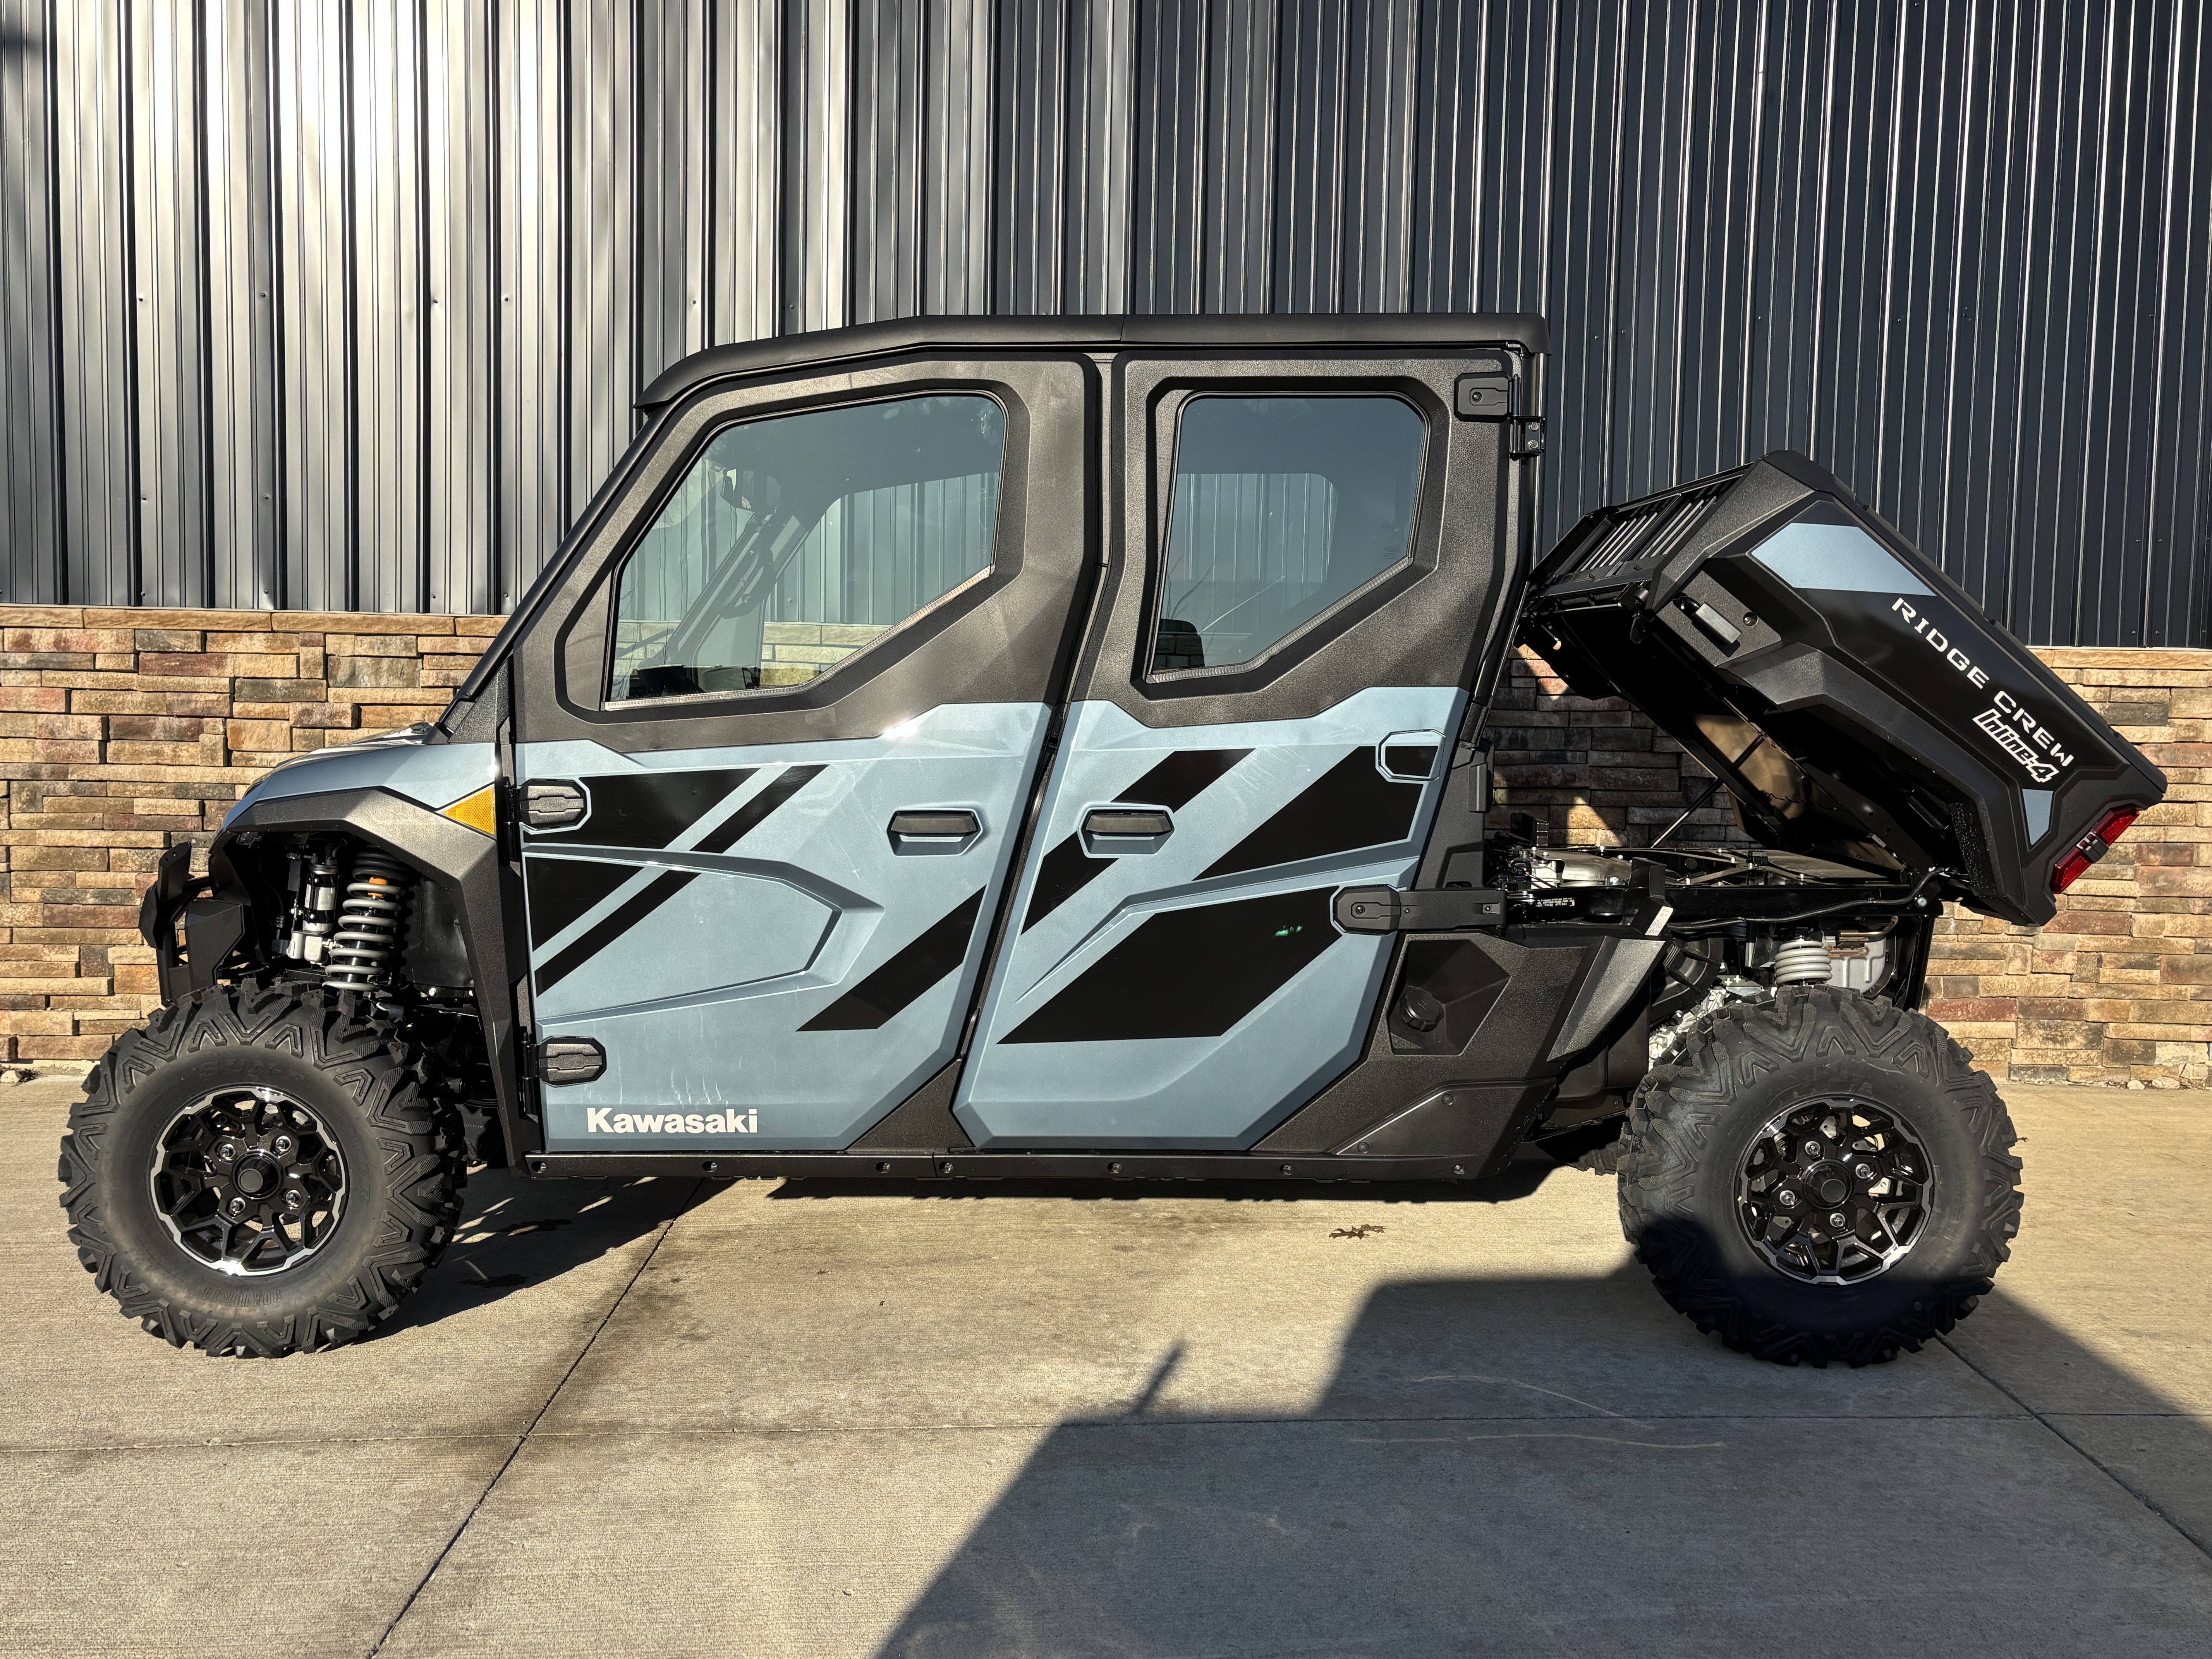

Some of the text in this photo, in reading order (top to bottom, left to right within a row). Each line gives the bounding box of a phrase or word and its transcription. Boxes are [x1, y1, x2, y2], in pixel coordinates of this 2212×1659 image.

[1891, 597, 2074, 767] RIDGE CREW
[1972, 708, 2059, 783] Inline-4
[587, 1108, 757, 1133] Kawasaki
[200, 1286, 281, 1307] 30X10R14
